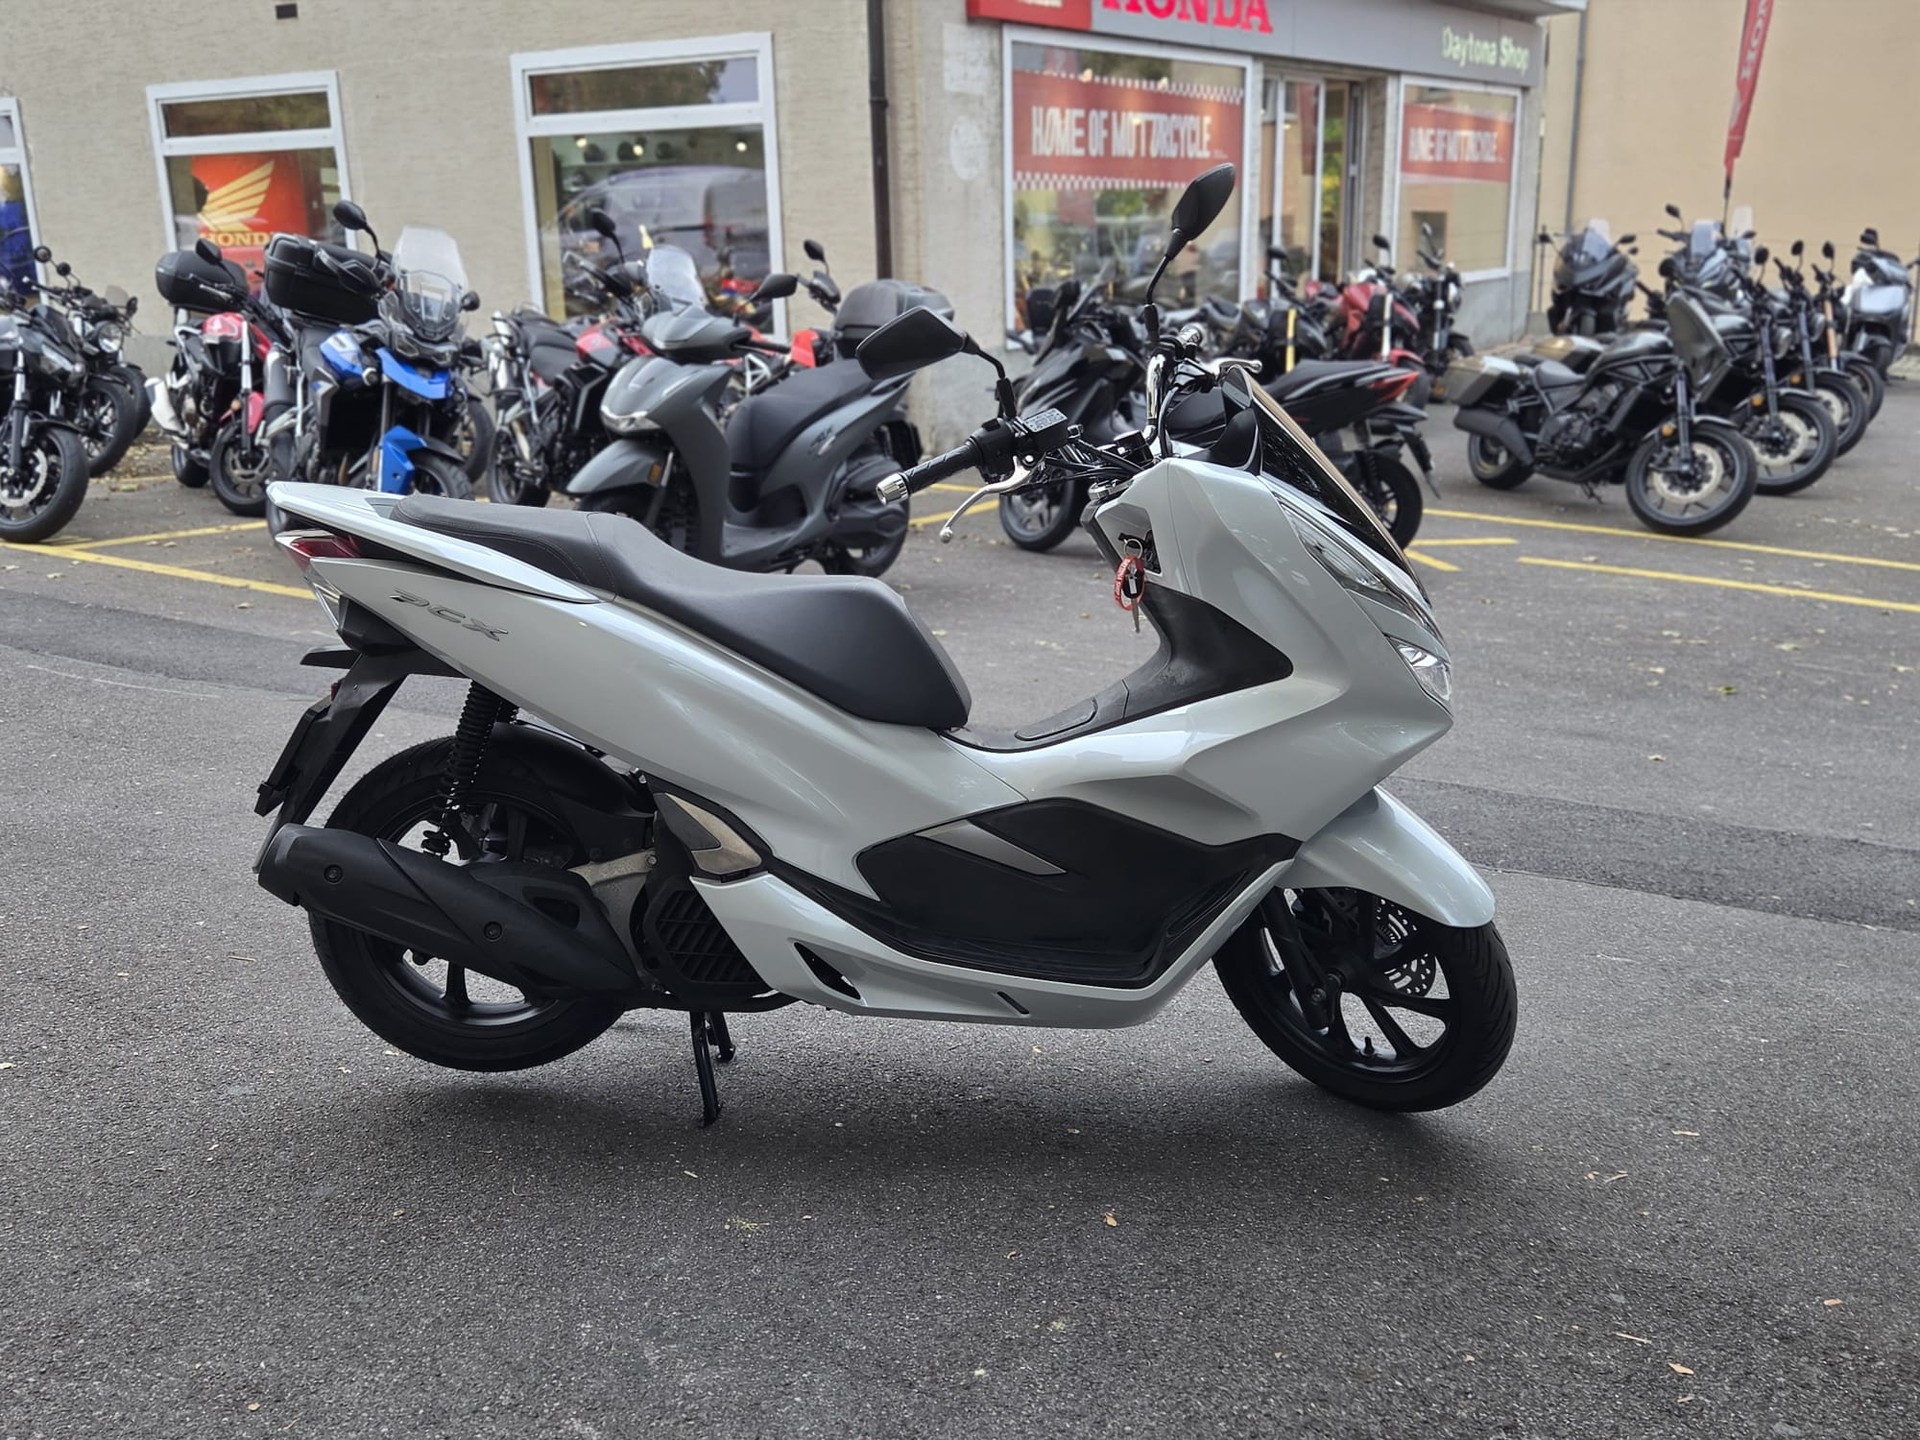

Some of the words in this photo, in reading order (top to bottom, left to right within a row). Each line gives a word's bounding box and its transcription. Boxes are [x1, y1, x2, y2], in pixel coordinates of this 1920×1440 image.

[1100, 0, 1273, 34] ONDA
[1442, 27, 1497, 68] Daytona
[1500, 36, 1529, 77] Shop
[1031, 105, 1086, 157] HOME
[1088, 109, 1109, 158] OF
[200, 231, 272, 247] HOND
[389, 586, 509, 641] PCX
